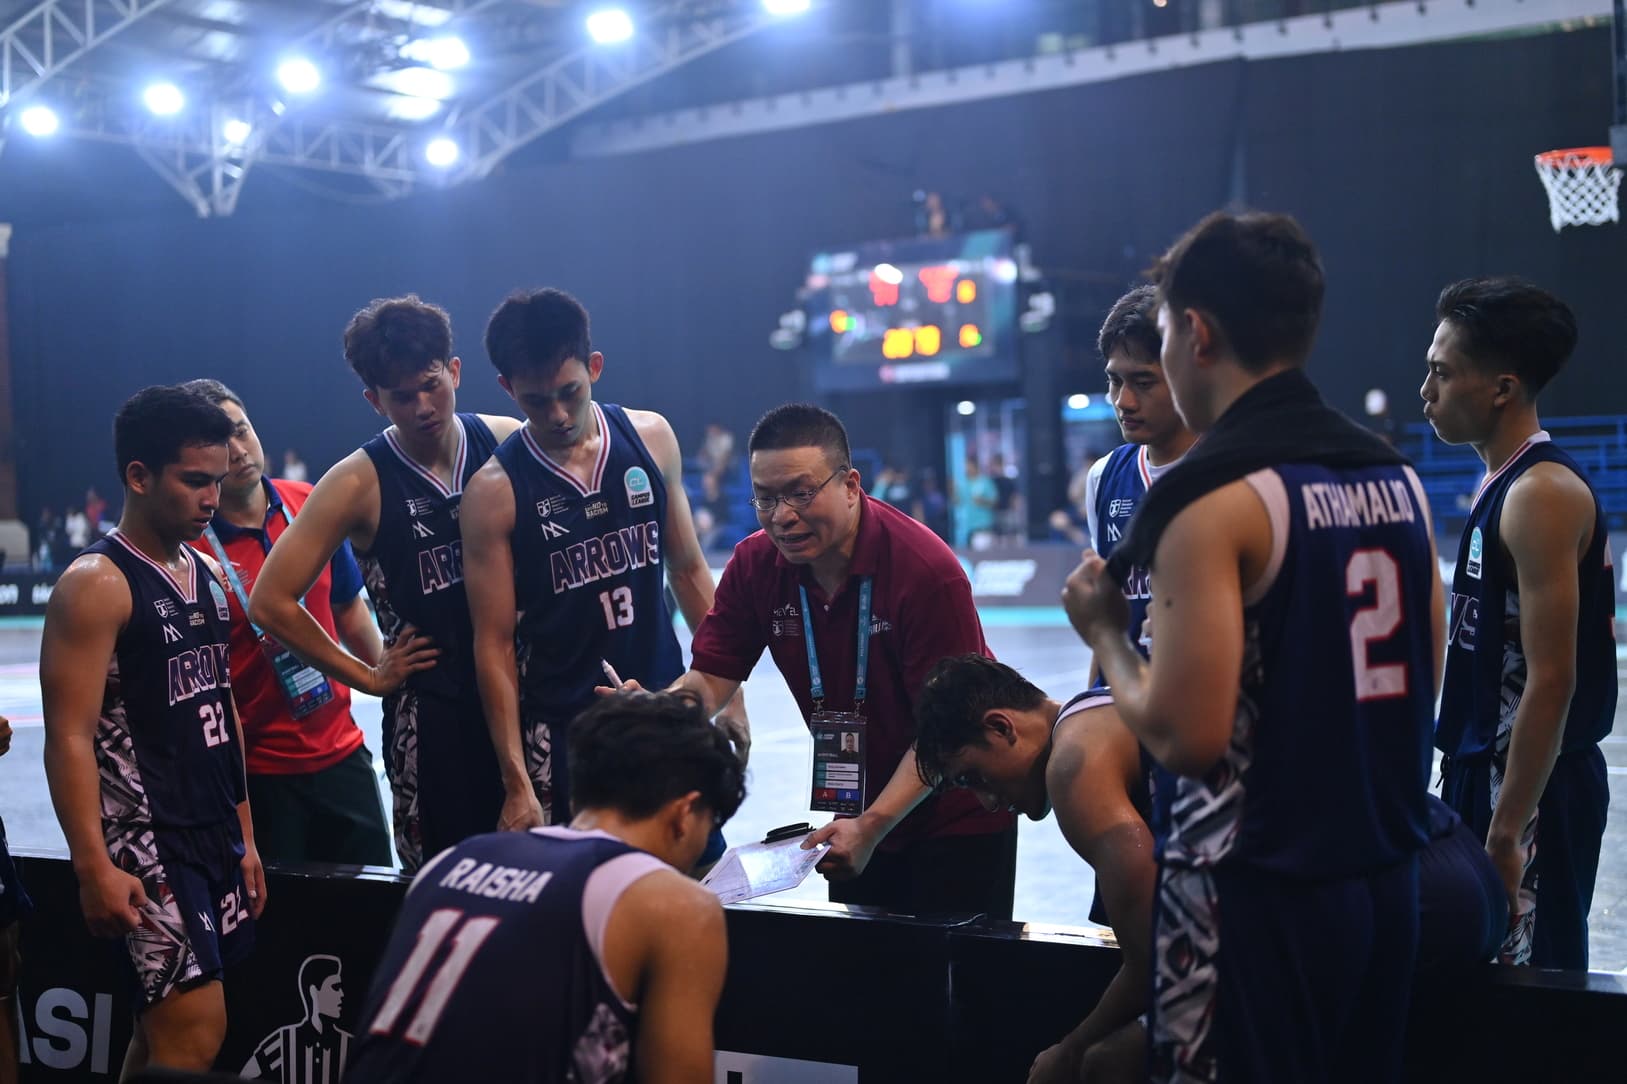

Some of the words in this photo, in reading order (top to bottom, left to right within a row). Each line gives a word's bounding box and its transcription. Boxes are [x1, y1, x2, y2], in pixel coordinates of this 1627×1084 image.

[550, 521, 659, 594] ARROWS
[600, 586, 635, 631] 13
[1345, 547, 1409, 702] 2
[438, 857, 554, 904] RAISHA
[368, 908, 502, 1047] 11
